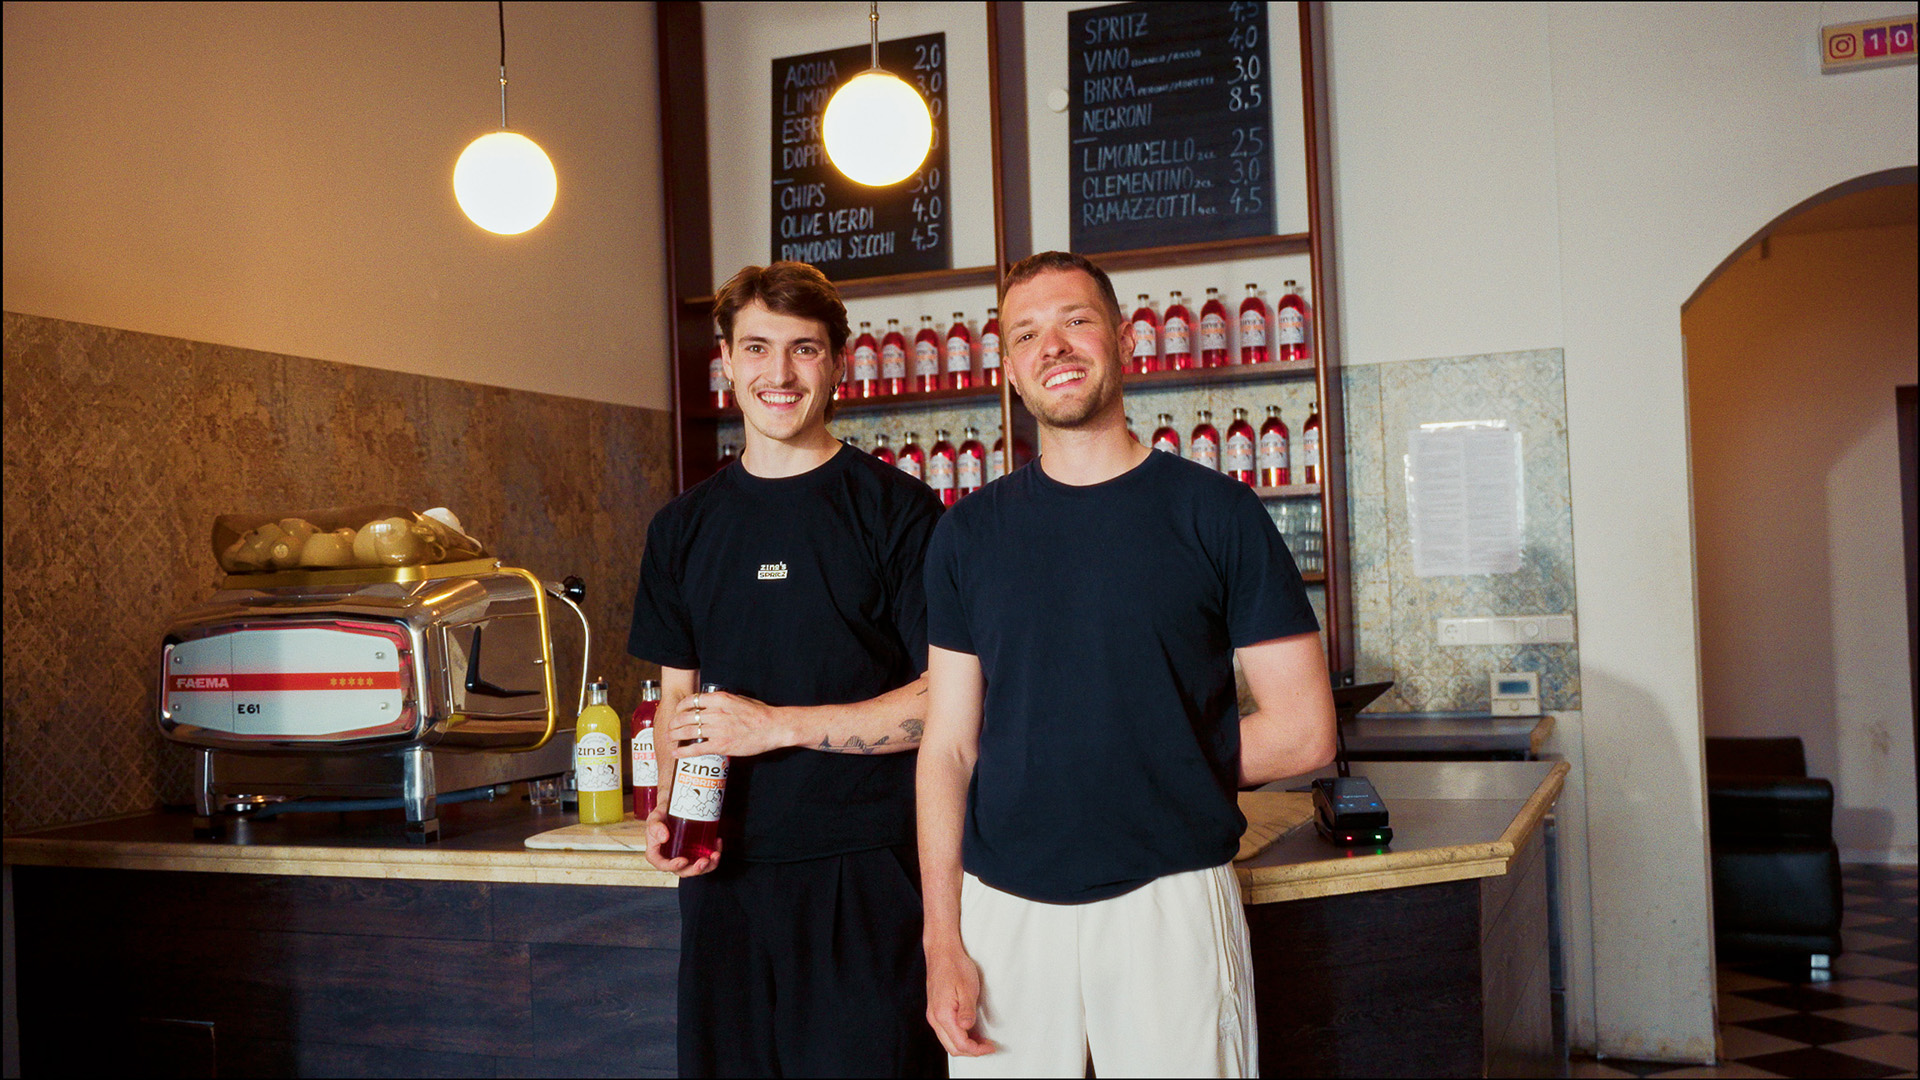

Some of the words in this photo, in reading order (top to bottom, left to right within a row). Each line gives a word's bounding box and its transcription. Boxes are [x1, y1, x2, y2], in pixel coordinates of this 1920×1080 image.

[1085, 13, 1149, 45] SPRITZ
[784, 59, 838, 90] ACQUA
[1084, 47, 1130, 73] VINO
[783, 87, 835, 115] LIMO
[1083, 75, 1136, 105] BIRRA
[782, 115, 821, 145] ESPR
[1083, 103, 1153, 133] NEGRONI
[783, 143, 830, 170] DOPPI
[1083, 137, 1195, 172] LIMONCELLO
[780, 184, 826, 210] CHIPS
[1083, 166, 1194, 200] CLEMENTINO
[780, 212, 825, 239] OLIVE
[829, 207, 874, 233] VERDI
[1083, 193, 1196, 227] RAMAZZOTTI
[781, 238, 842, 263] POMODORI
[848, 232, 895, 259] SECCHI
[176, 678, 229, 688] FAEMA
[238, 704, 260, 714] E61
